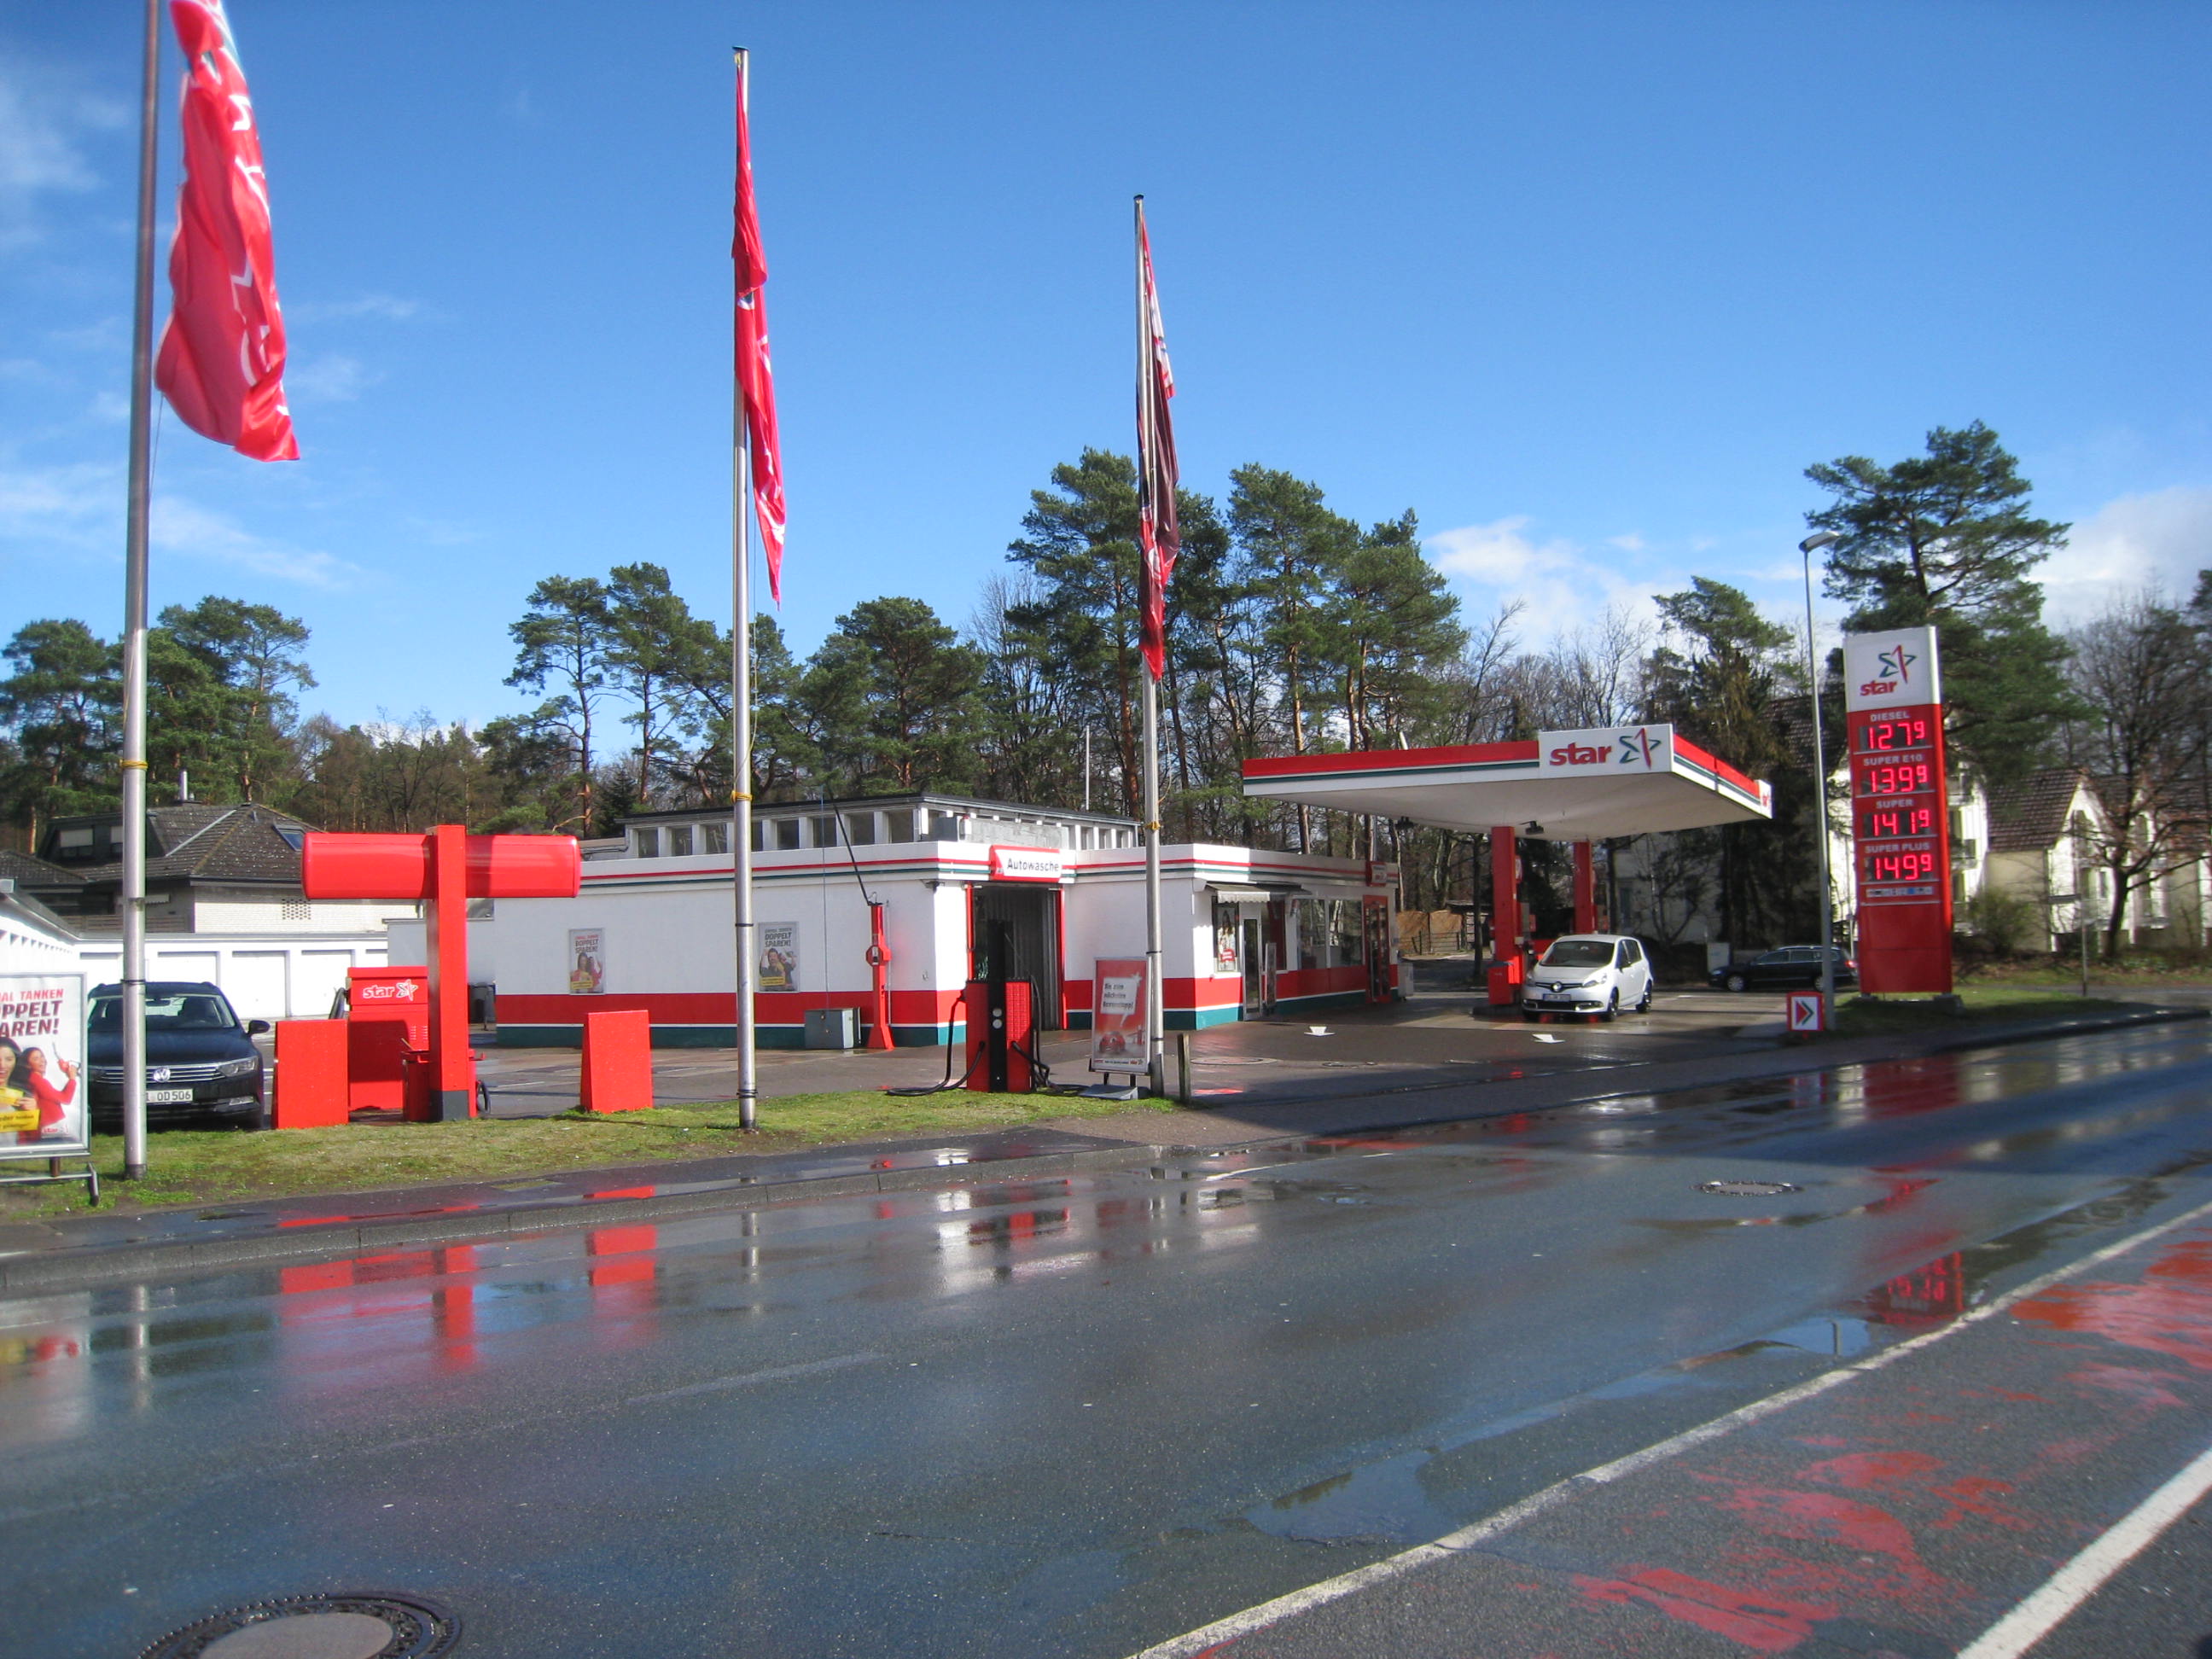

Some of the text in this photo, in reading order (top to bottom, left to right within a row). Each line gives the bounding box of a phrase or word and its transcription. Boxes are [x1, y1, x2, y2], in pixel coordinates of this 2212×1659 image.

[1860, 680, 1897, 696] star
[1871, 711, 1910, 722] DIESEL
[1869, 720, 1925, 750] 1279
[1549, 742, 1612, 765] star
[1864, 754, 1924, 766] SUPER E10
[1871, 765, 1927, 793] 1399
[1876, 799, 1914, 809] SUPER
[1873, 809, 1930, 836] 1419
[1865, 841, 1930, 853] SUPER PLUS
[1876, 853, 1932, 880] 1499
[20, 988, 64, 1001] TANKEN
[362, 985, 395, 998] star
[0, 1000, 63, 1020] PPELT
